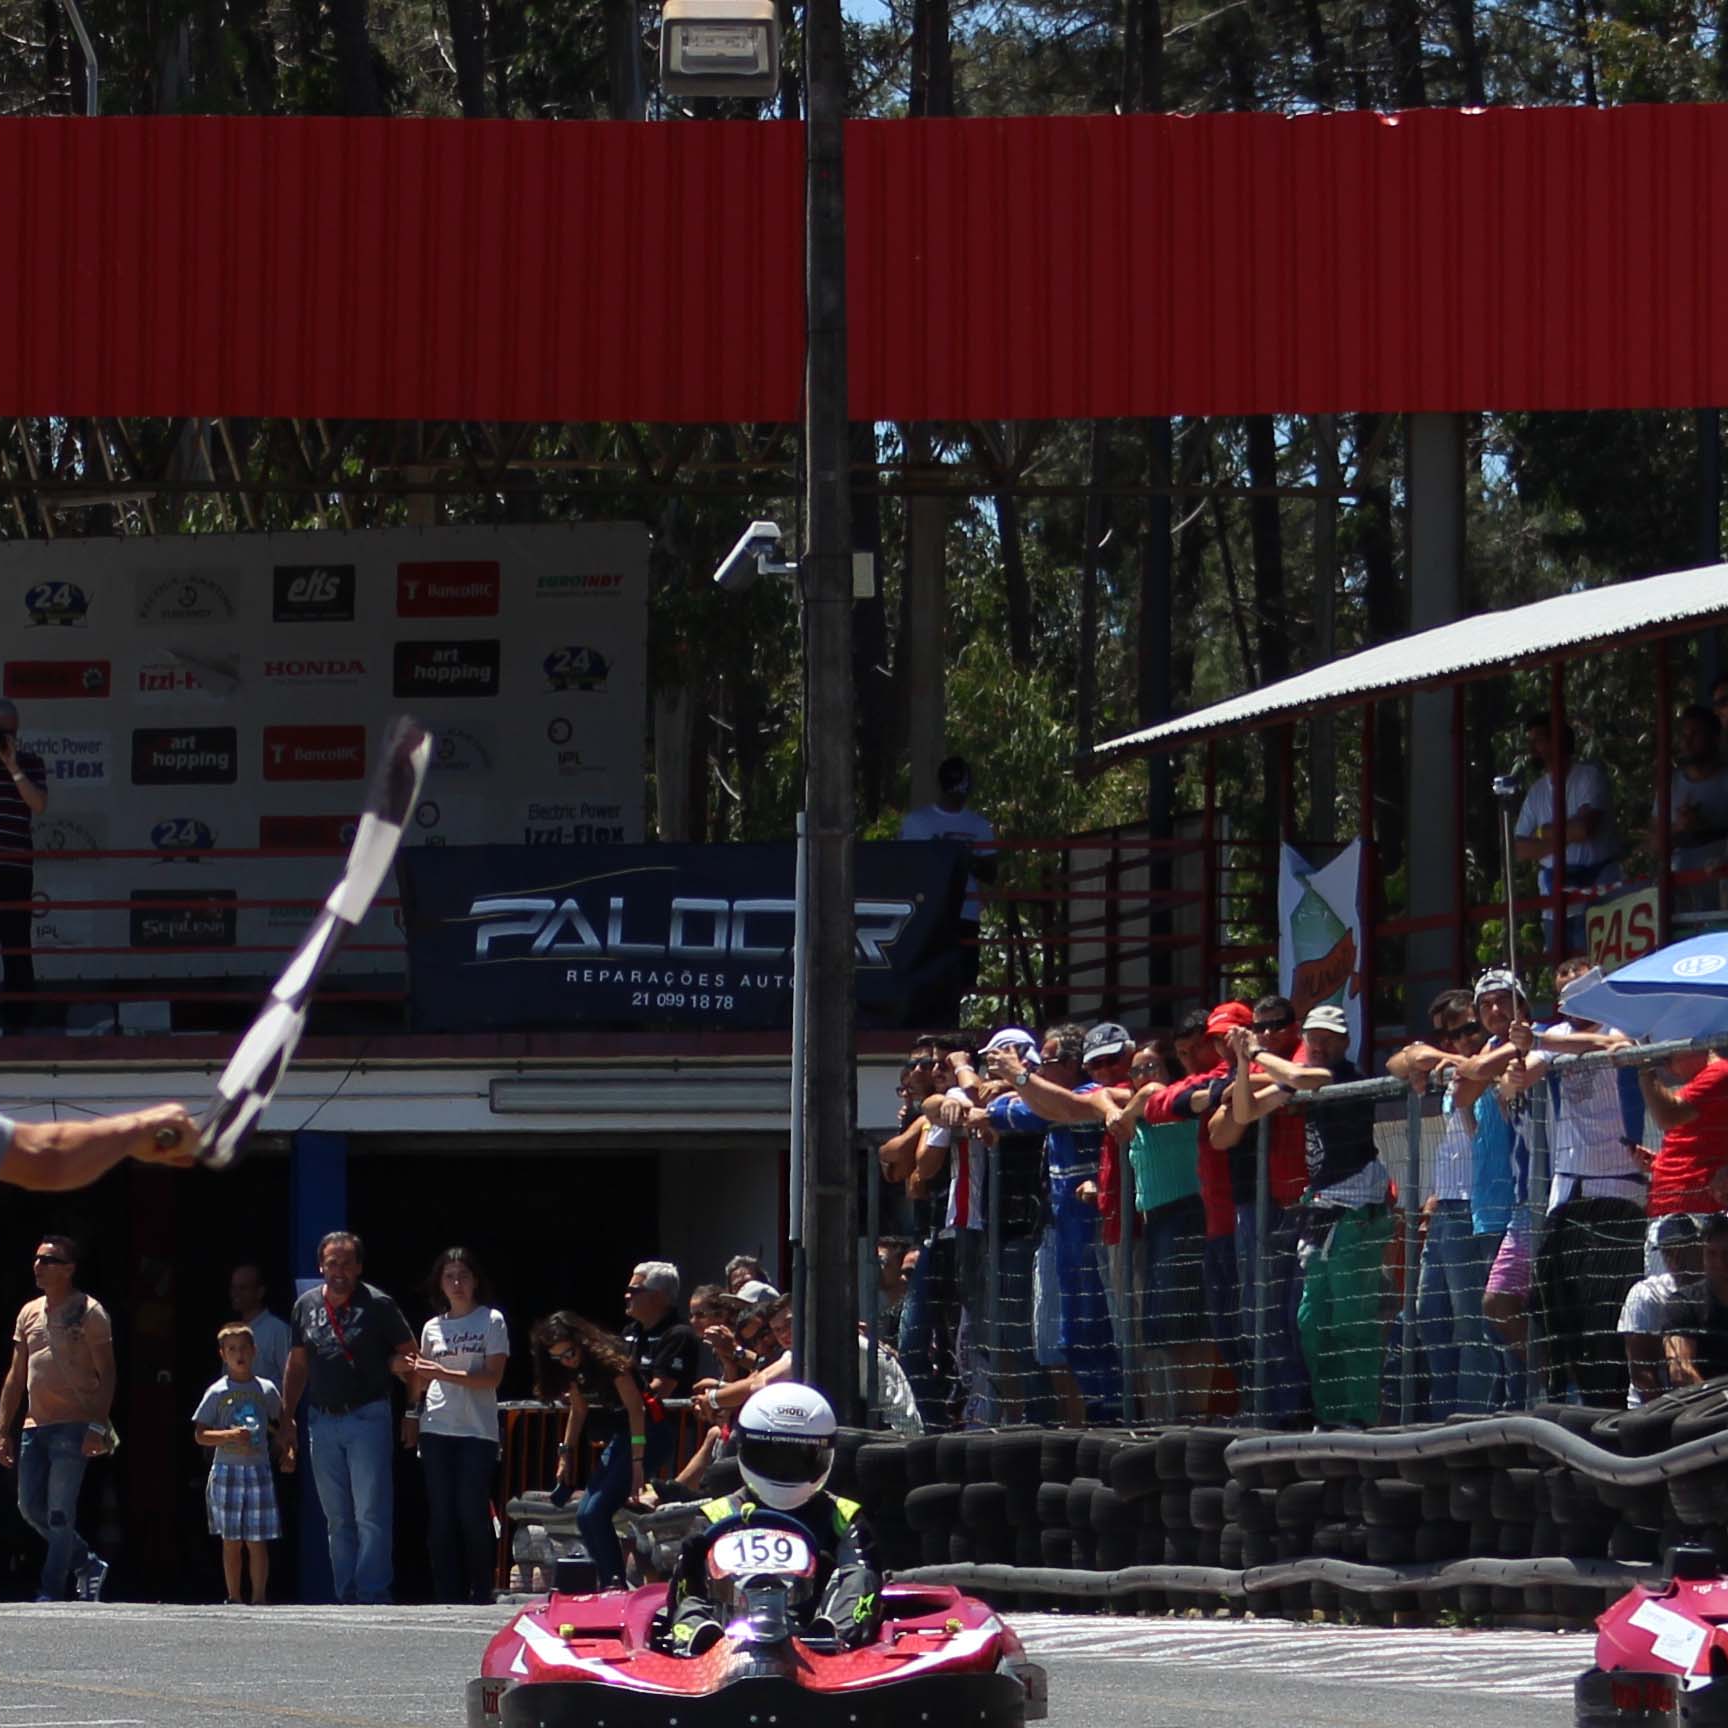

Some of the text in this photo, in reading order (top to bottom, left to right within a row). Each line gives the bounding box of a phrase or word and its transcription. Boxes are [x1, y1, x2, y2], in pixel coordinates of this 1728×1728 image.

[33, 584, 72, 609] 24
[264, 660, 367, 676] HONDA
[553, 649, 591, 673] 24
[16, 737, 103, 755] lectric Power
[48, 760, 104, 779] -Flex
[527, 801, 622, 820] Electric Power
[159, 821, 198, 846] 24
[469, 896, 914, 968] PALOCR
[1587, 902, 1656, 964] GAS
[566, 967, 726, 990] REPARAÇÕES
[631, 992, 734, 1011] 21 099 18 78
[308, 1306, 364, 1328] 187
[732, 1535, 793, 1566] 159
